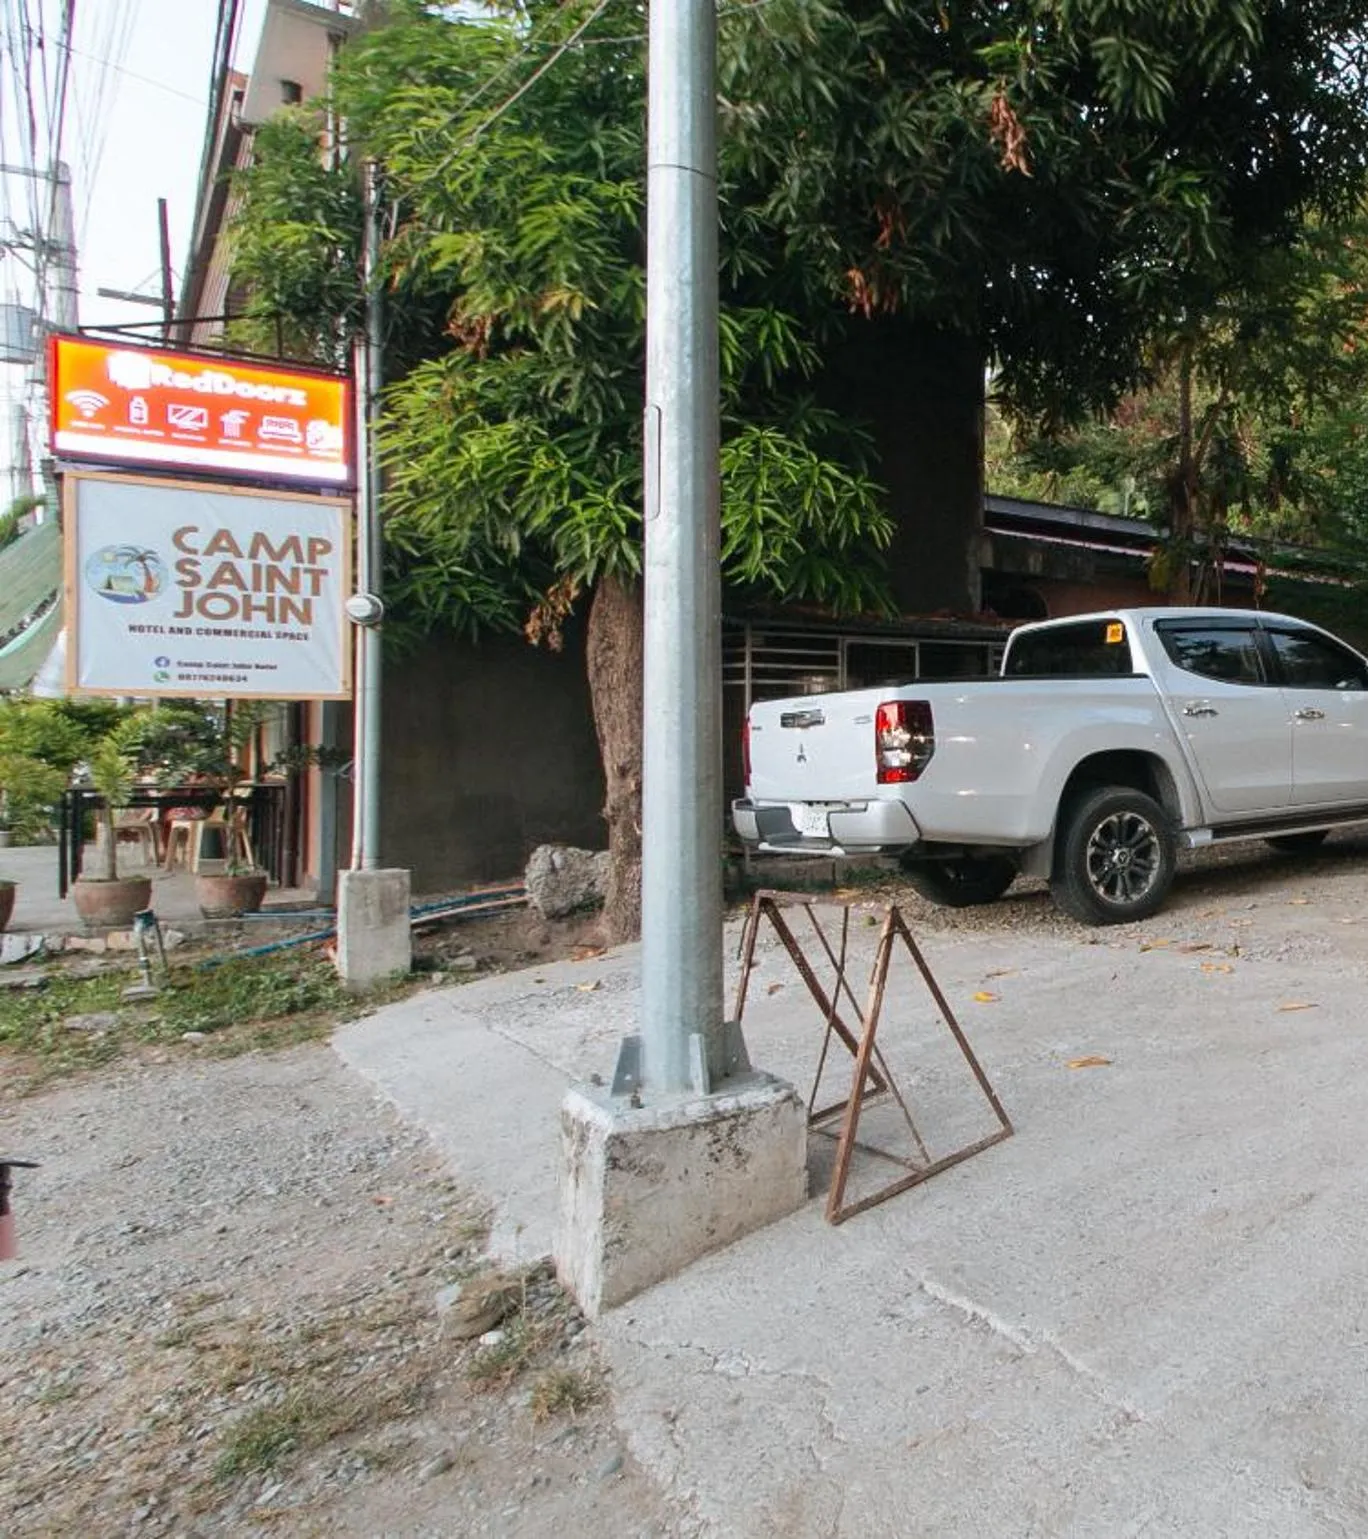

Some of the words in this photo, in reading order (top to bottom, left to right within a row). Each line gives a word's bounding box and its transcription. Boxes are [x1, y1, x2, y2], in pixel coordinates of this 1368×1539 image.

[171, 525, 333, 566] CAMP
[174, 557, 329, 597] SAINT
[173, 590, 313, 626] JOHN
[128, 624, 166, 635] HOTEL
[168, 626, 193, 636] AND
[195, 627, 273, 640] COMMERCIAL
[275, 631, 310, 642] SPACE
